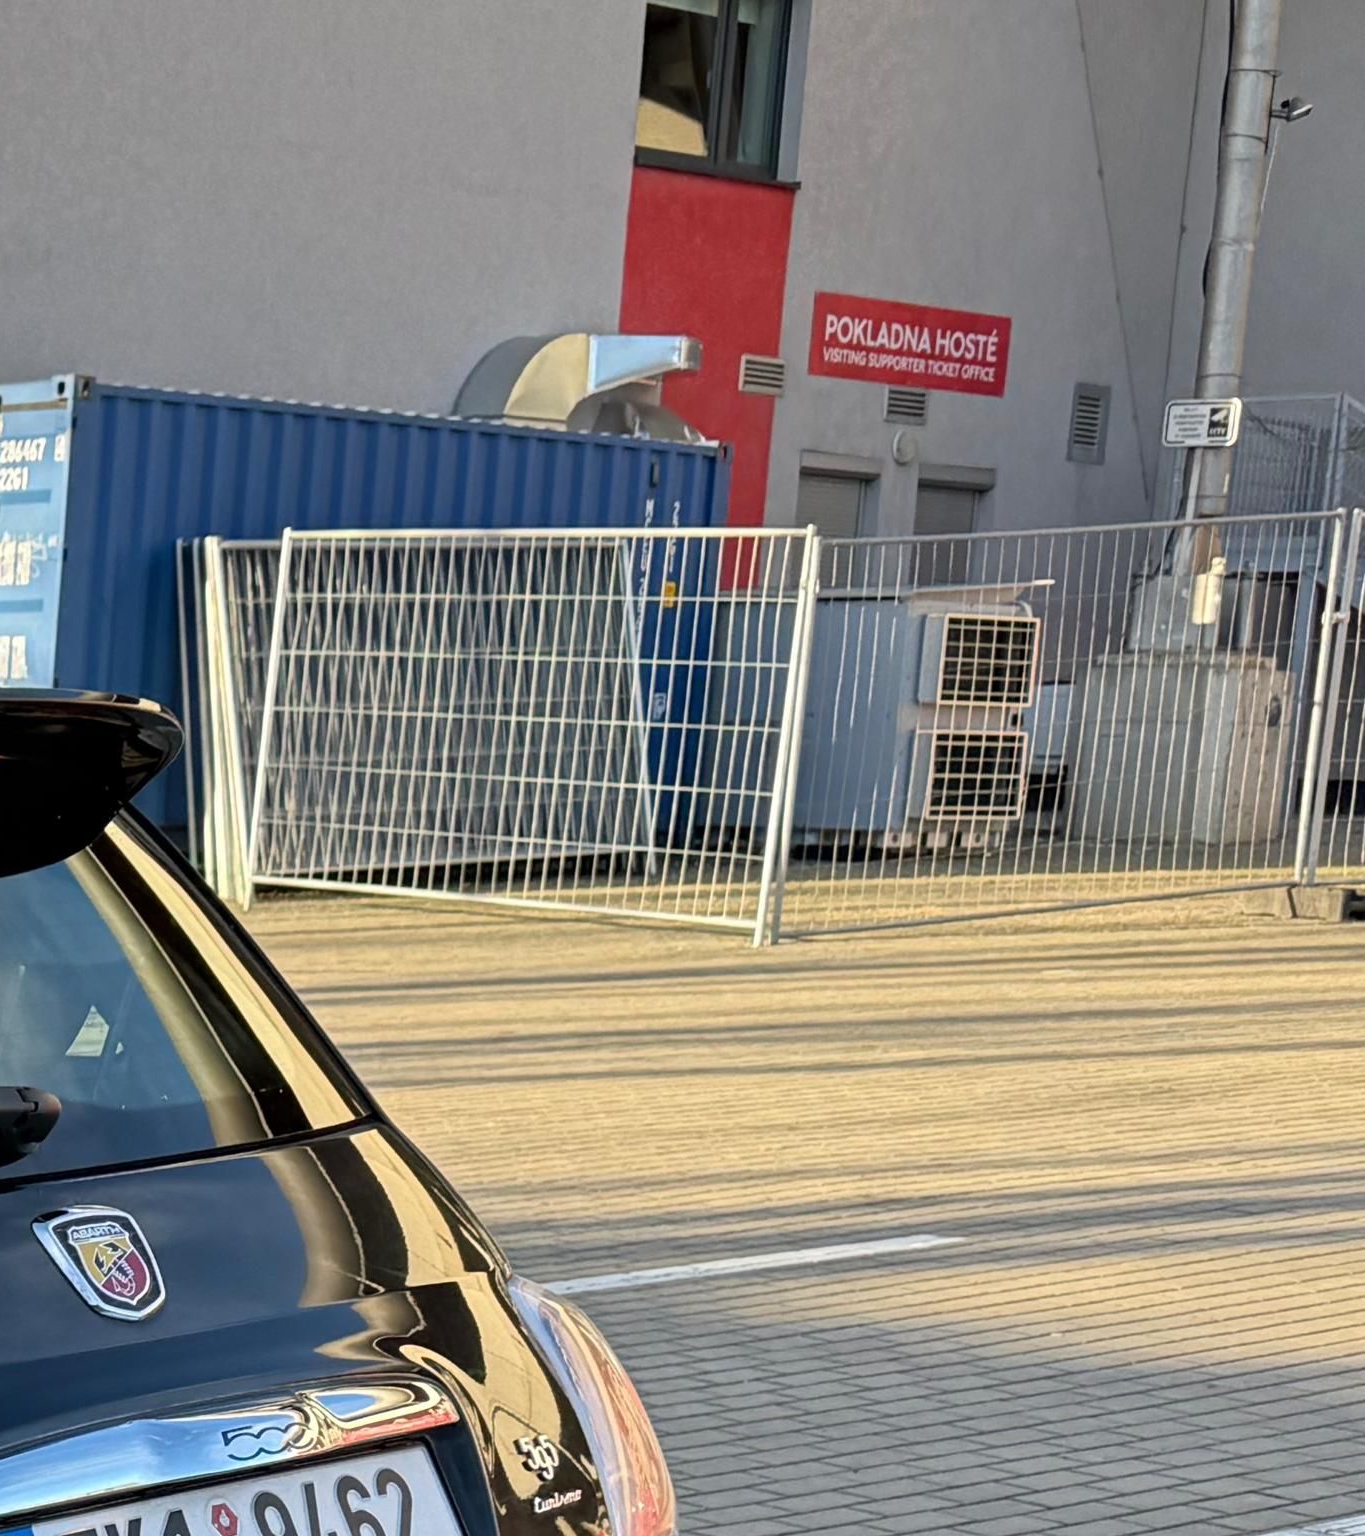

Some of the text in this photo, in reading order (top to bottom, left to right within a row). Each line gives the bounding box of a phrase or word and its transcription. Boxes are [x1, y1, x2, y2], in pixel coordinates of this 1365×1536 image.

[825, 314, 999, 363] POKLADNA HOSTÉ
[823, 346, 996, 382] VISITING SUPPORTER TICKET OFFICE
[0, 437, 46, 464] 286467
[72, 1226, 121, 1239] ABARTH
[519, 1434, 559, 1480] 595
